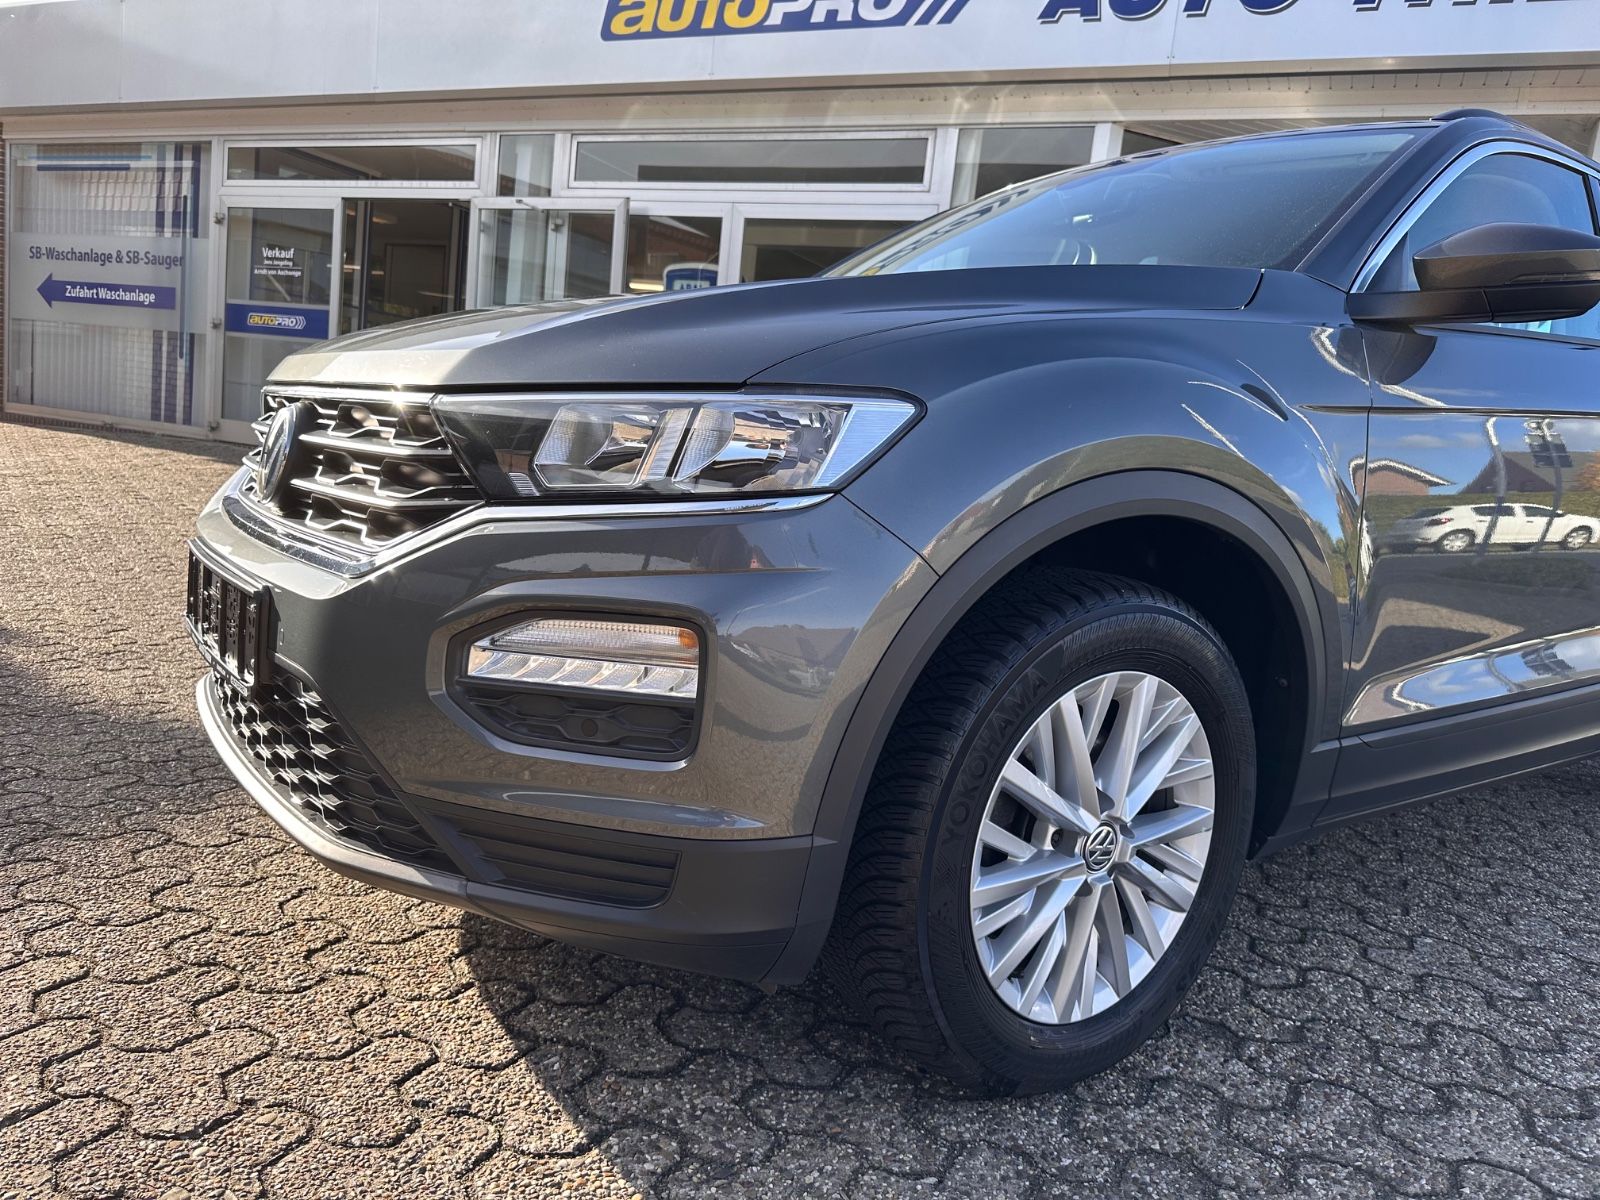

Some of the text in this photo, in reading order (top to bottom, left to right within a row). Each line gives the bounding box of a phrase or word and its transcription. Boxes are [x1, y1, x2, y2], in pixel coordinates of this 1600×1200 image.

[29, 246, 184, 270] SB-Waschanlage & SB-Sauger
[262, 247, 294, 258] Verkauf
[65, 285, 156, 305] Zufahrt Waschanlage
